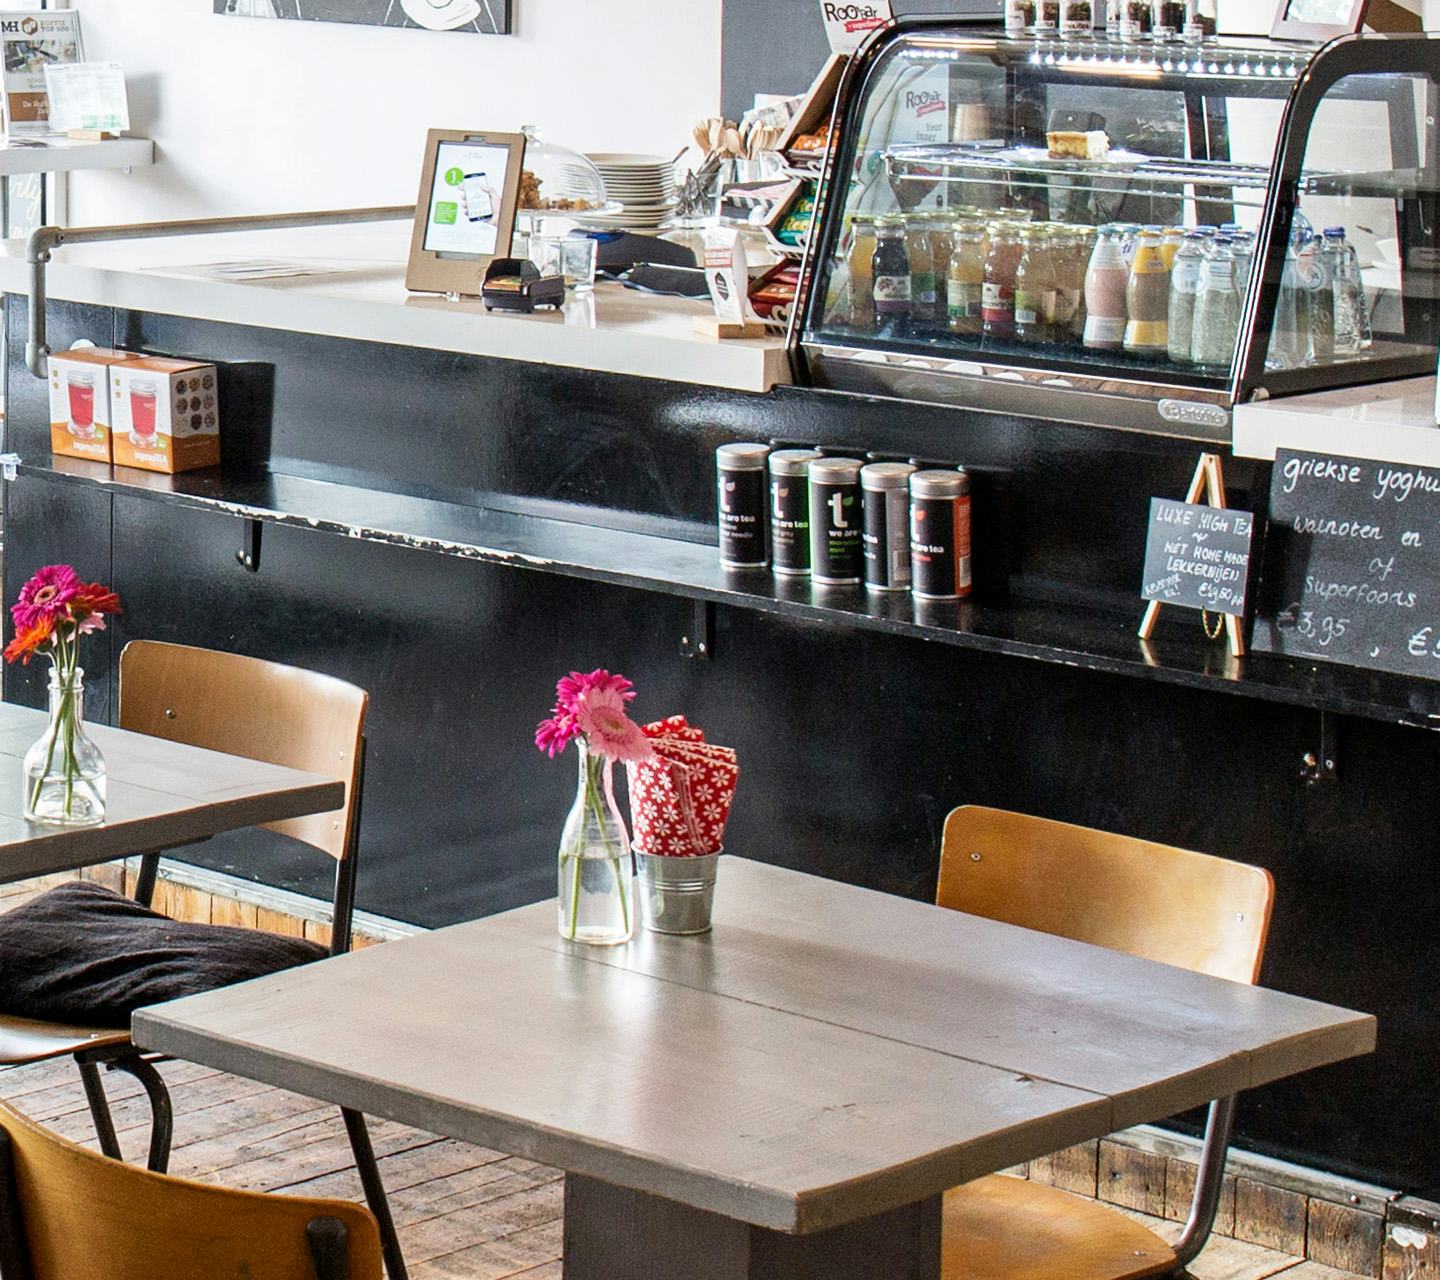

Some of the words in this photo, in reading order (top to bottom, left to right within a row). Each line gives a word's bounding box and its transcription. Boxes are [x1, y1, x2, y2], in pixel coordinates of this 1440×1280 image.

[1283, 458, 1361, 493] griekse
[741, 514, 755, 523] tea
[1156, 505, 1192, 525] LUXE
[1233, 516, 1252, 538] TEA
[1401, 528, 1422, 547] en
